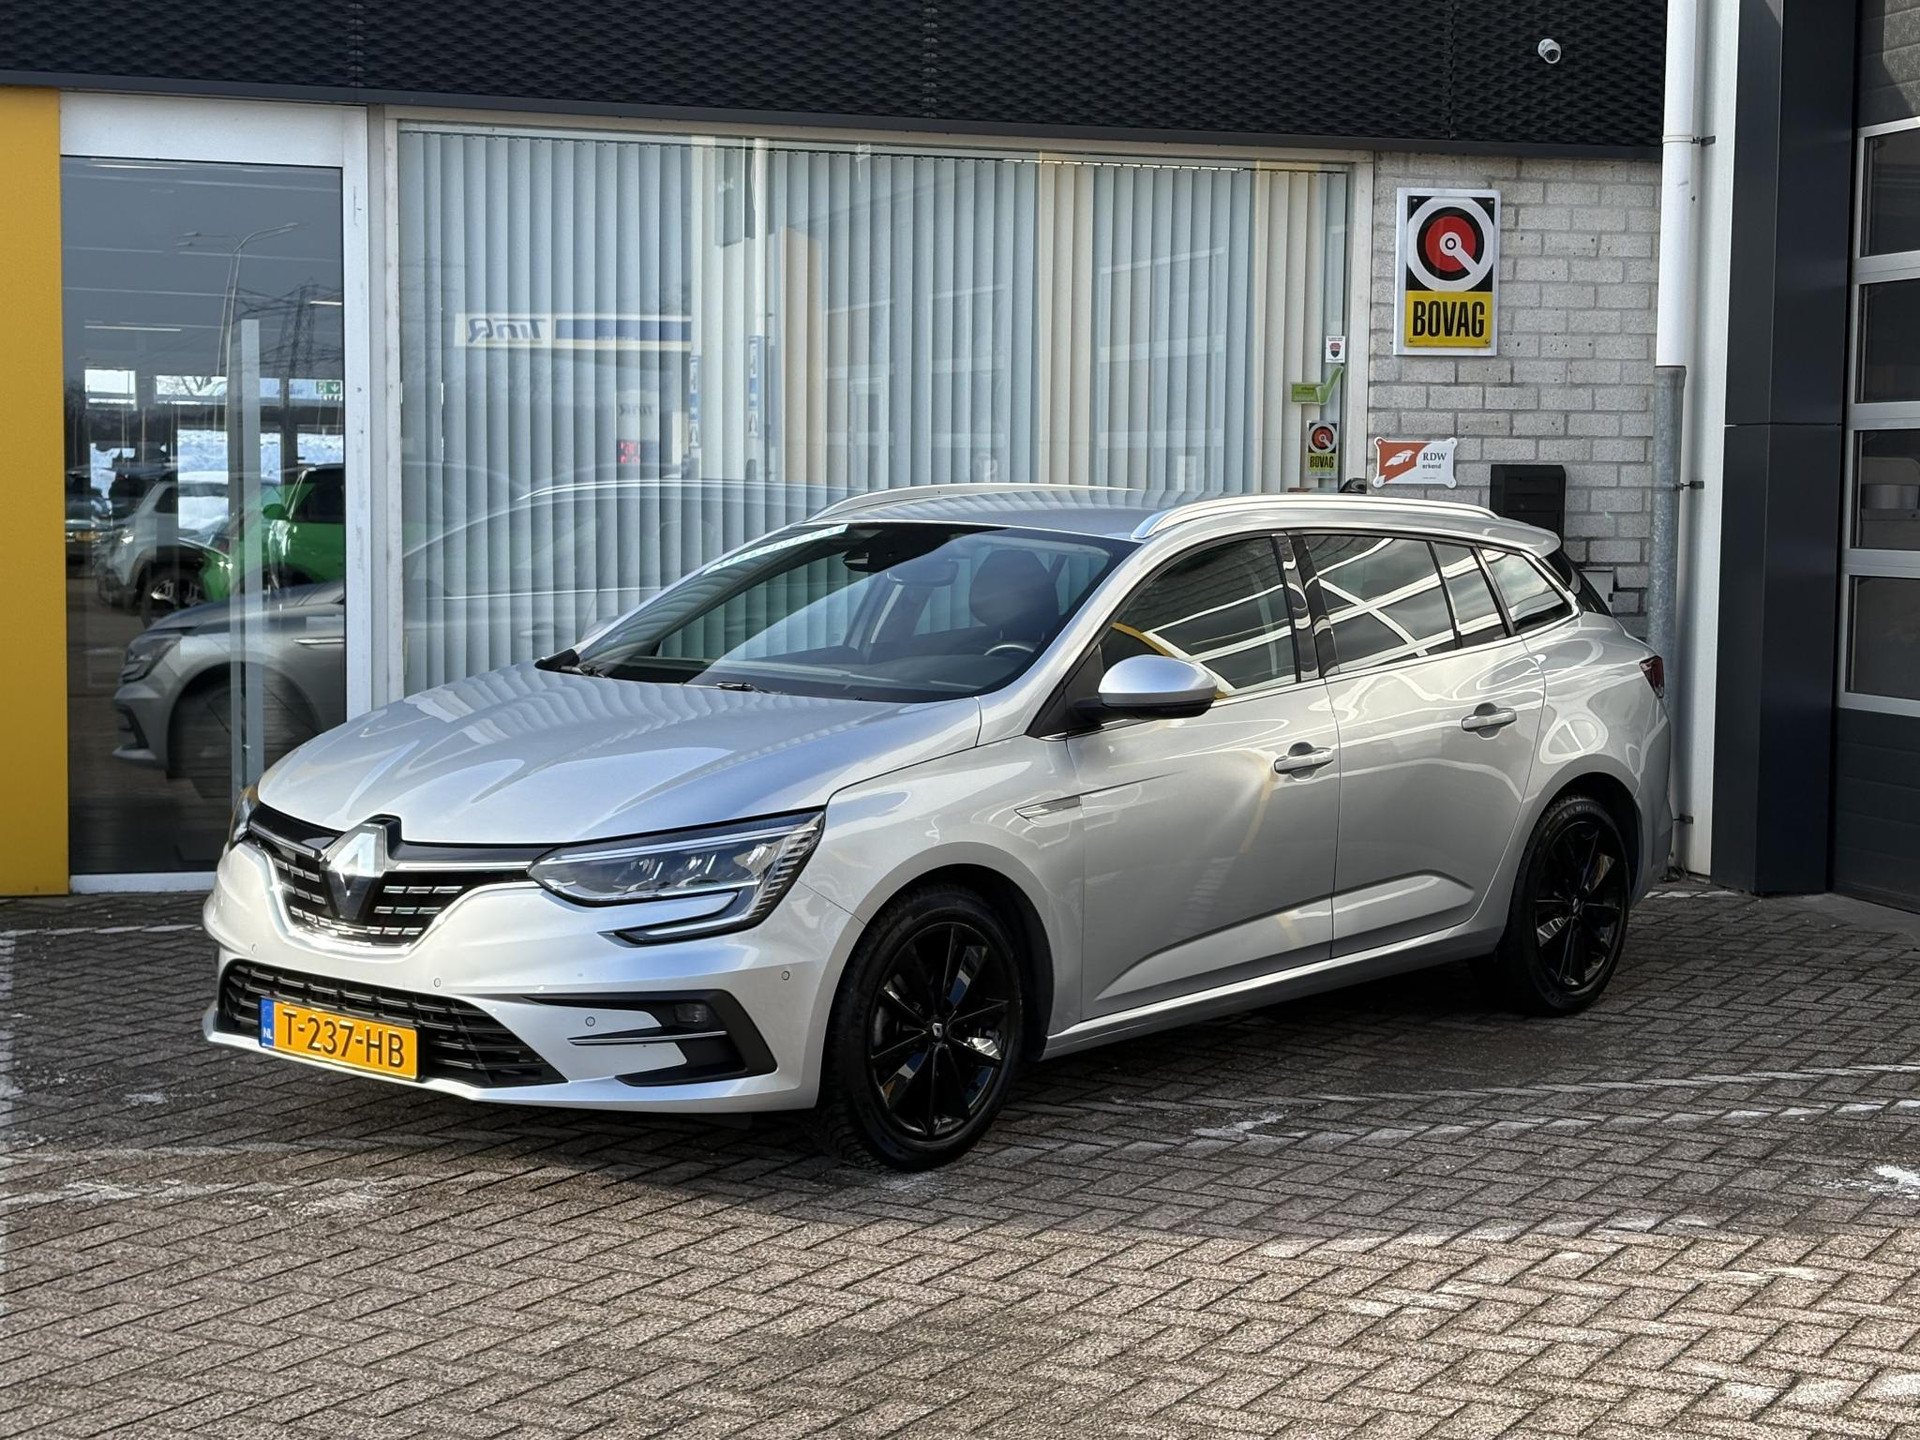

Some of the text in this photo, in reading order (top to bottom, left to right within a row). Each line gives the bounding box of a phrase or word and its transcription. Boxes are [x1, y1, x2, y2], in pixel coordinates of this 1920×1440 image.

[1412, 300, 1485, 337] BOVAG
[1309, 455, 1334, 468] BOVAG
[1422, 452, 1447, 461] RDW
[263, 1028, 273, 1039] NL
[283, 1009, 405, 1068] T-237-HB
